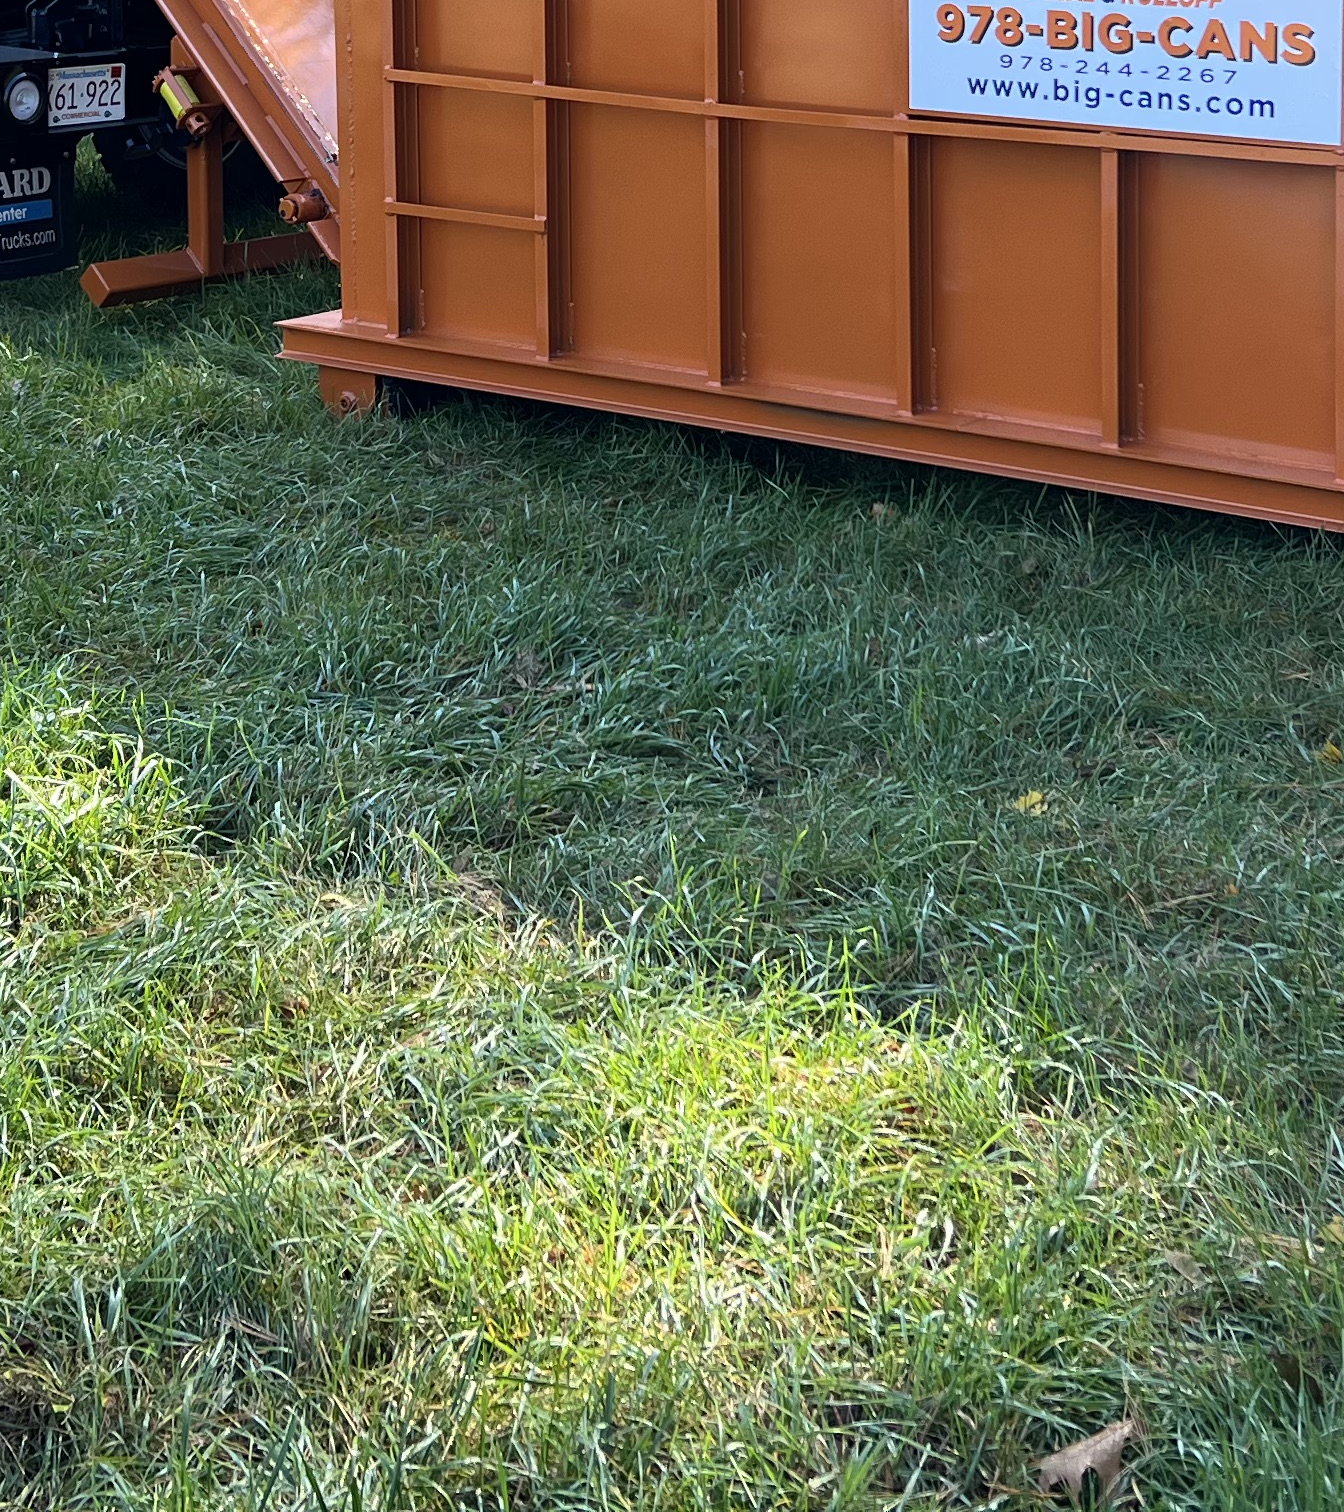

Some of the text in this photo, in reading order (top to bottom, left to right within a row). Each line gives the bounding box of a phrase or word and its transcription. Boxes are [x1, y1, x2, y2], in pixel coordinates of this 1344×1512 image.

[936, 3, 1316, 66] 978-BIG-CANS
[1000, 54, 1238, 85] 978-244-2267
[967, 76, 1275, 118] www.big-cans.com
